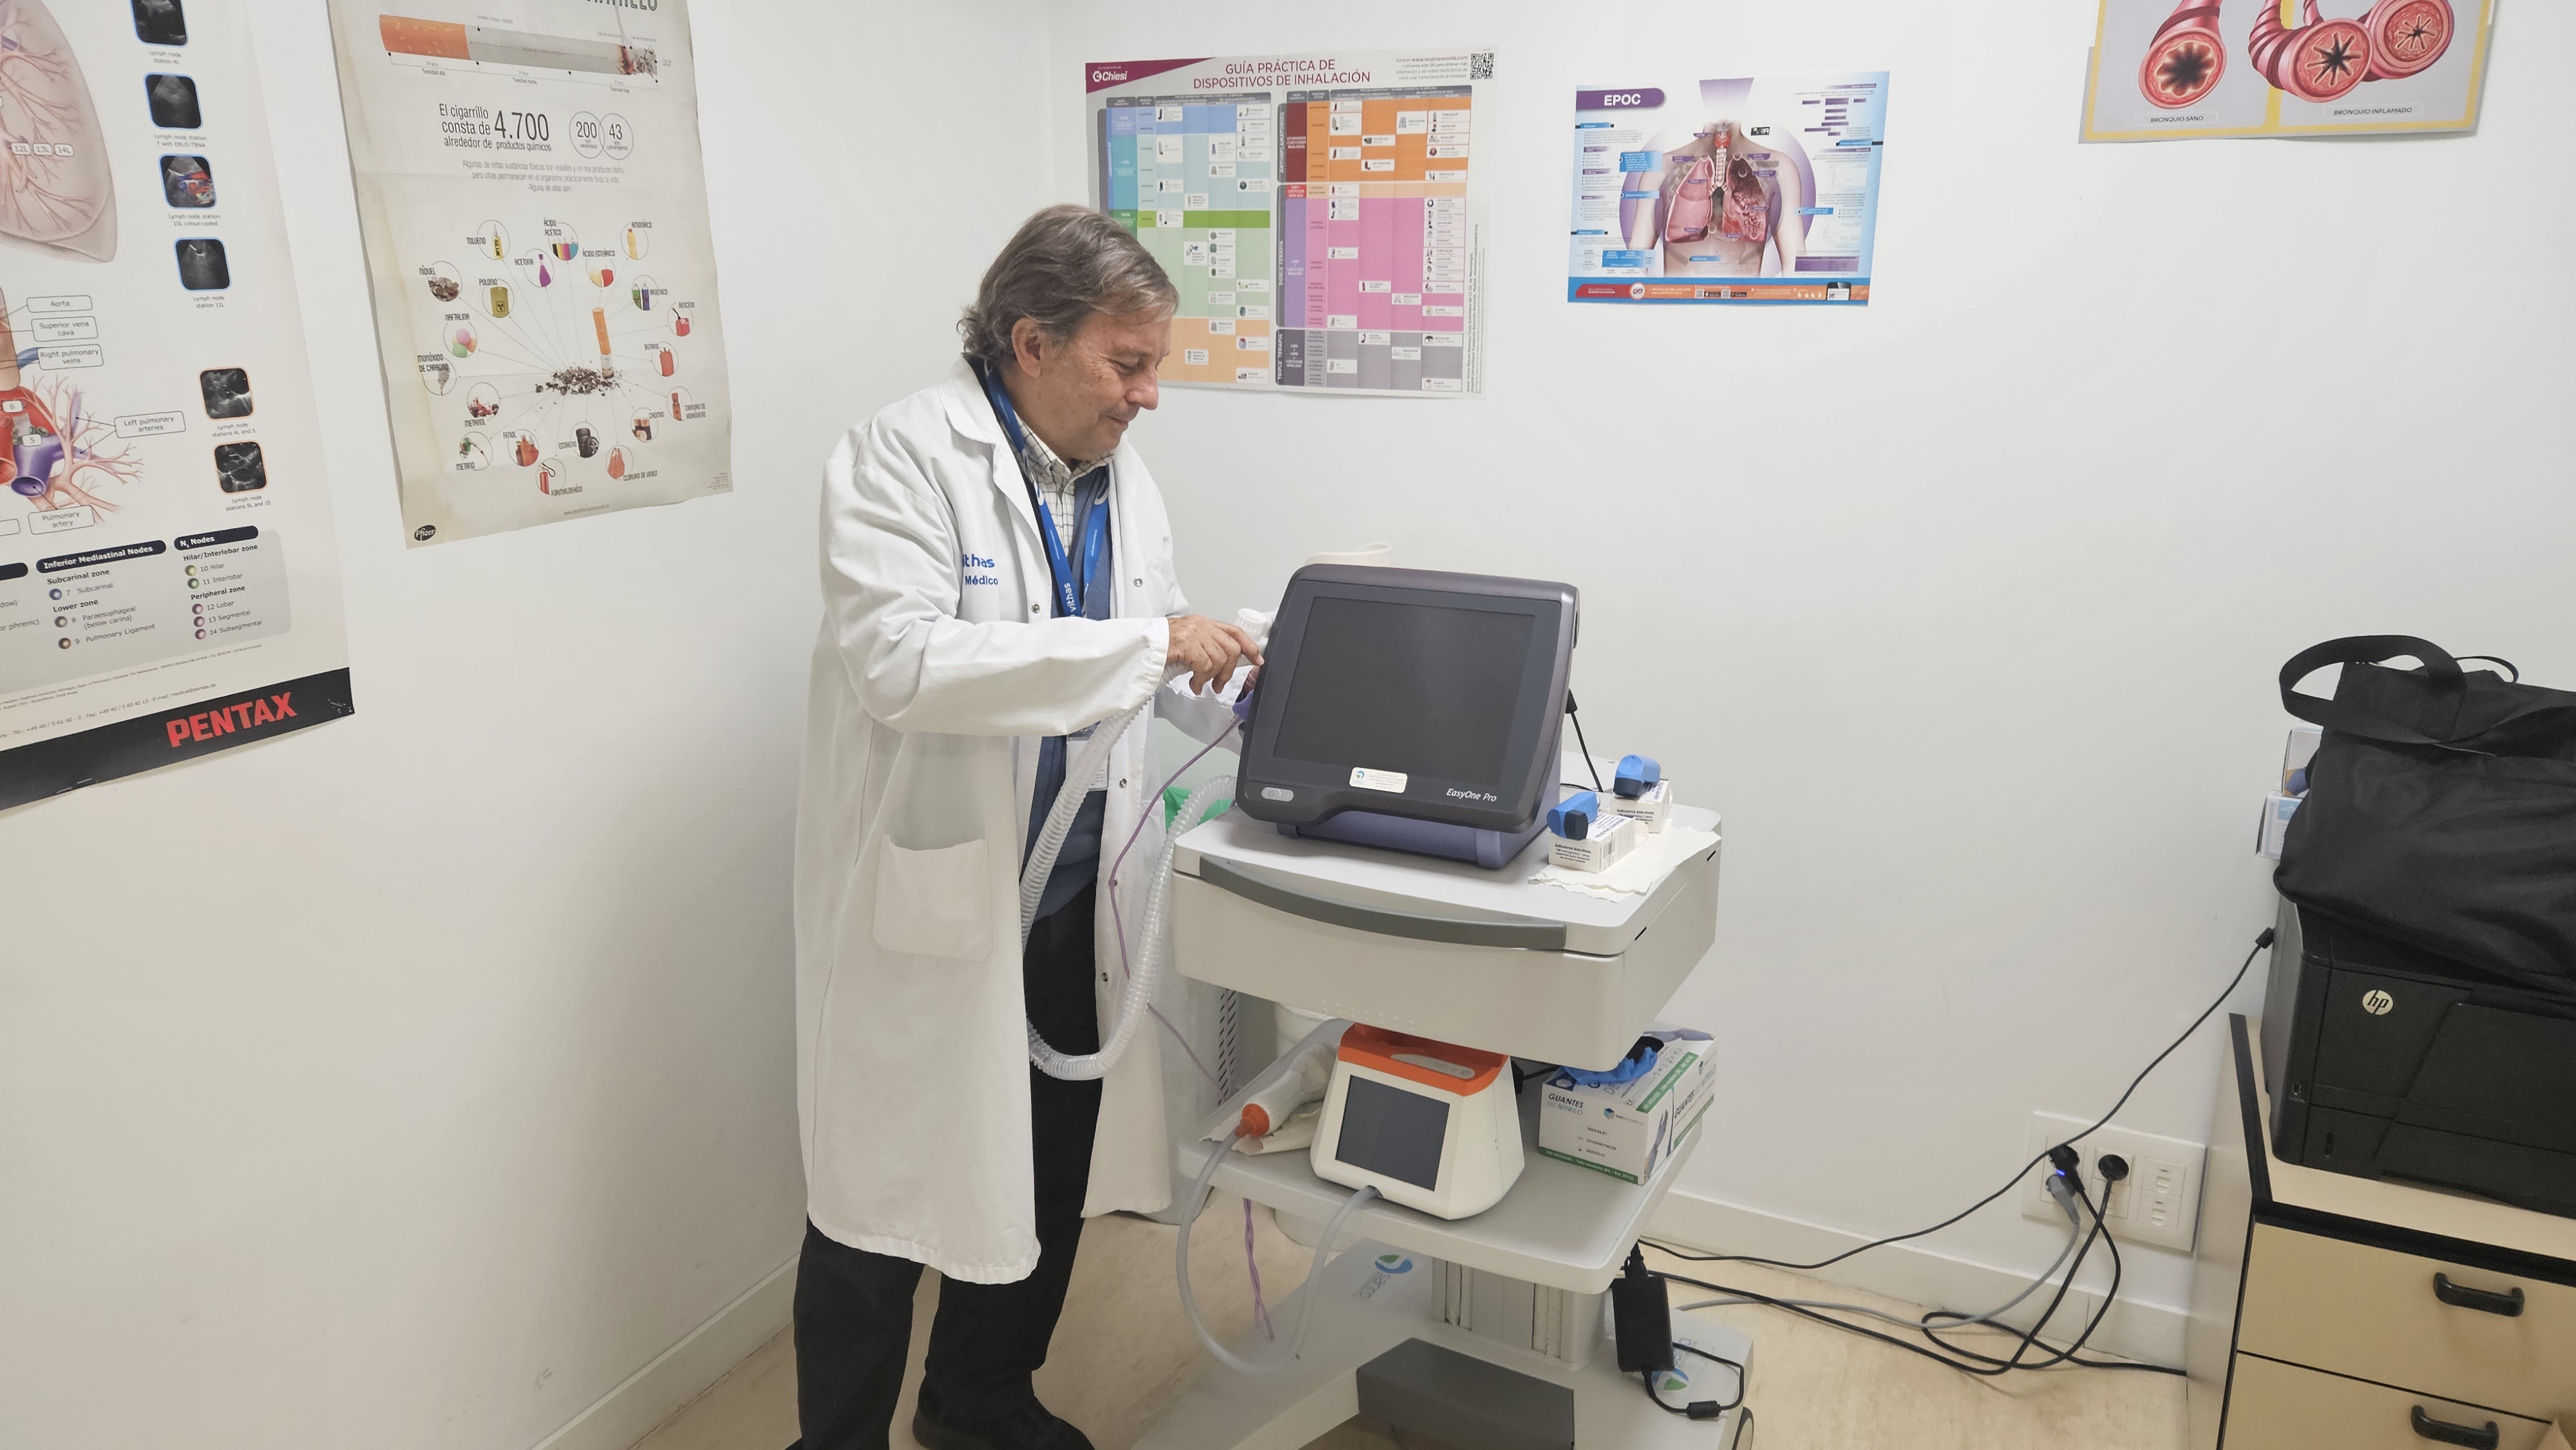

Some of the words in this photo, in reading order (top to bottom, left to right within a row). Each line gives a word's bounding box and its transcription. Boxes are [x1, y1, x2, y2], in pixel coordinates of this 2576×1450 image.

[1226, 61, 1254, 75] GUÍA
[1258, 59, 1316, 73] PRÁCTICA
[1319, 59, 1336, 71] DE
[1102, 71, 1128, 81] Chiesi
[1193, 75, 1273, 89] DISPOSITIVOS
[1276, 75, 1292, 86] DE
[1294, 69, 1370, 85] INHALACIÓN
[1604, 93, 1641, 106] EPOC
[439, 103, 447, 117] El
[451, 105, 488, 120] cigarrillo
[442, 121, 475, 135] consta
[478, 122, 490, 135] de
[494, 110, 549, 141] 4.700
[576, 121, 597, 138] 200
[609, 124, 622, 140] 43
[444, 137, 480, 148] alrededor
[483, 138, 492, 149] de
[497, 141, 525, 152] productos
[527, 142, 551, 152] químicos
[419, 265, 436, 275] NÍQUEL
[417, 352, 444, 362] MONÓXIDO
[427, 363, 449, 372] CARBONO
[139, 416, 174, 425] pulmonary
[465, 419, 486, 427] METANOL
[456, 462, 475, 471] METANO
[43, 511, 79, 522] Pulmonary
[191, 536, 215, 545] Nodes
[415, 527, 436, 541] Pfizer
[44, 558, 77, 569] Inferior
[79, 550, 125, 563] Mediastinal
[128, 545, 153, 555] Nodes
[184, 548, 240, 561] Hilar/Interlobar
[47, 572, 89, 585] Subcarinal
[213, 574, 243, 583] Interlobar
[965, 576, 998, 585] Médico
[77, 583, 113, 594] Subcarinal
[191, 588, 227, 600] Peripheral
[1065, 583, 1077, 612] vithas
[53, 603, 77, 612] Lower
[82, 606, 136, 621] Paraesophageal
[218, 610, 251, 621] Segmental
[8, 619, 39, 630] phrenic)
[84, 619, 107, 630] (below
[109, 616, 132, 625] carina)
[219, 619, 262, 634] Subsegmental
[86, 630, 122, 643] Pulmonary
[124, 624, 155, 636] Ligament
[166, 692, 298, 748] PENTAX
[1446, 788, 1481, 800] EasyOne
[1482, 793, 1497, 802] Pro
[2367, 990, 2389, 1015] hp
[1548, 1093, 1584, 1108] GUANTES
[1557, 1104, 1583, 1115] NITRILO
